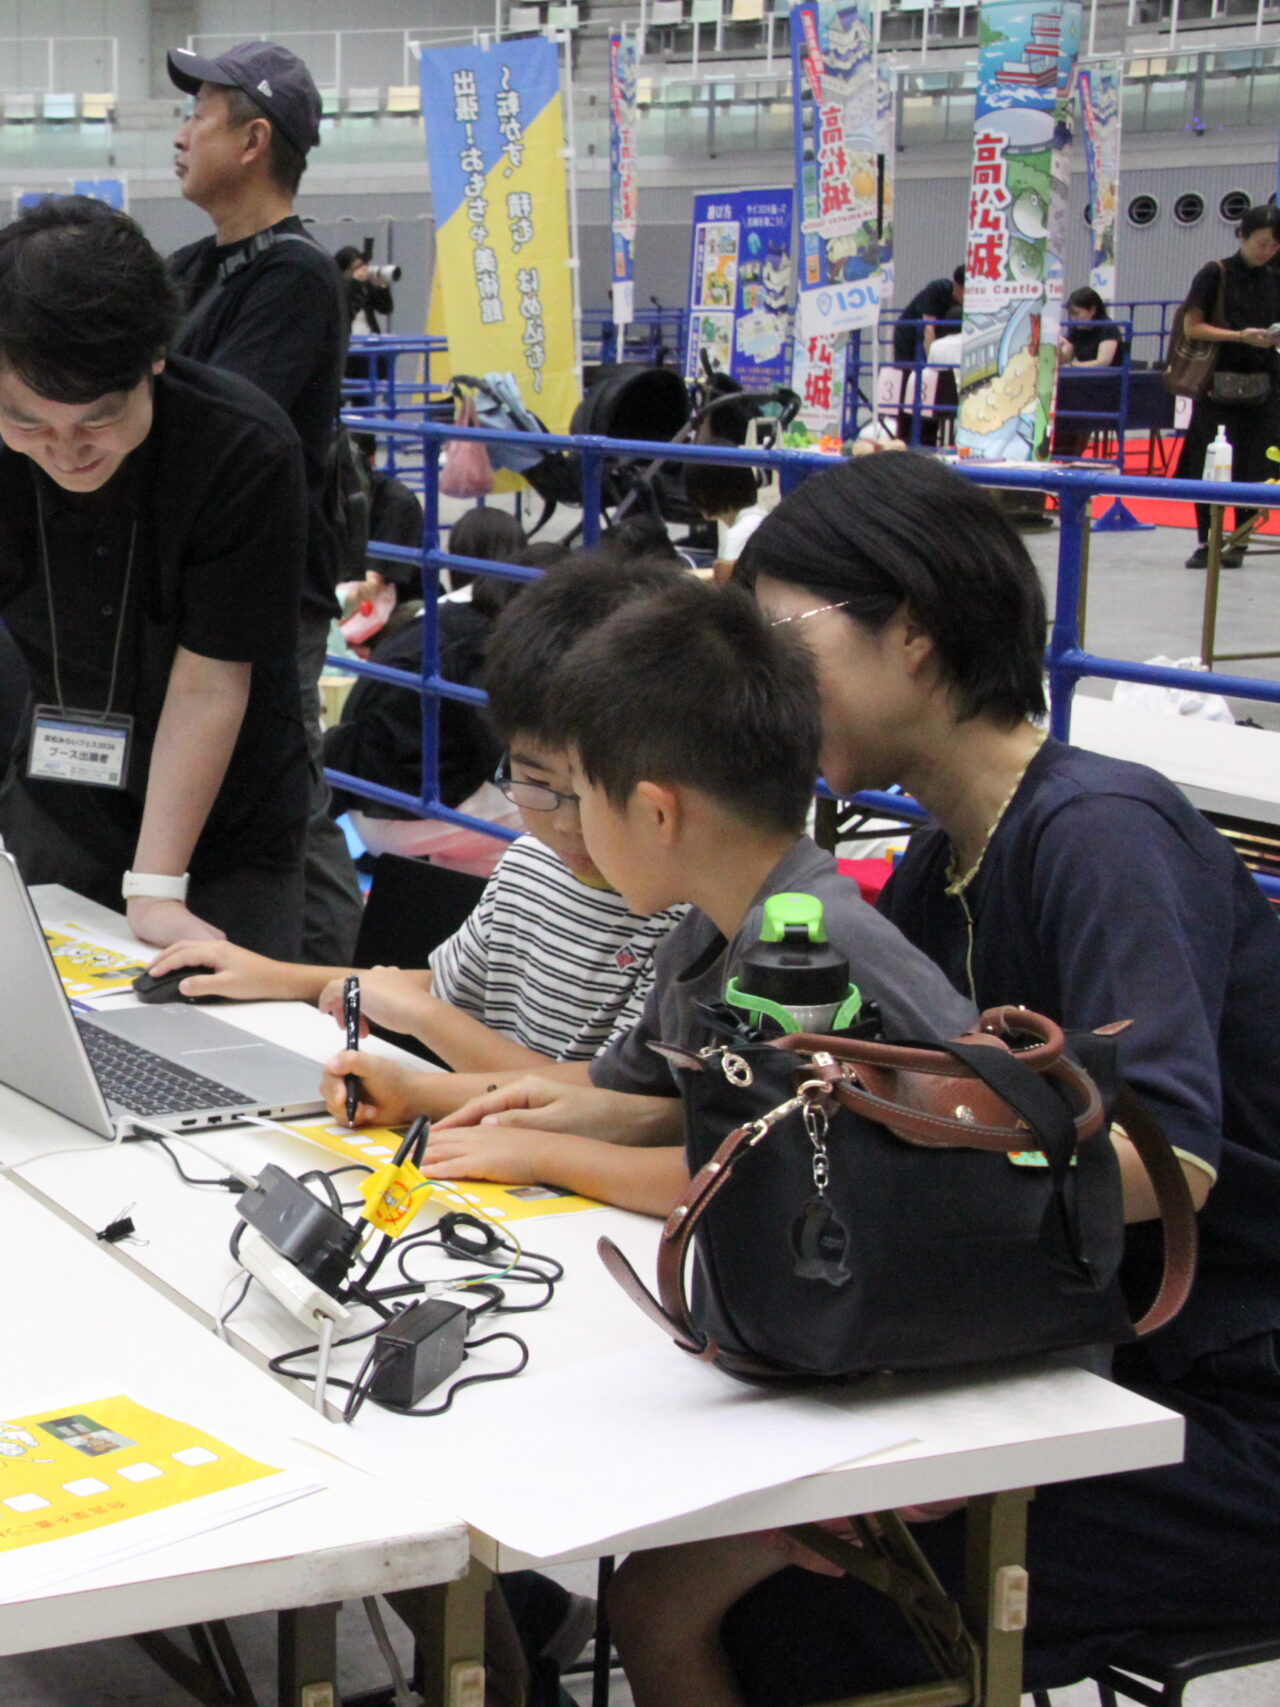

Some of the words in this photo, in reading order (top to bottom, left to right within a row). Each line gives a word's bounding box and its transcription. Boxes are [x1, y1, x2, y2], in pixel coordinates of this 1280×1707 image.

[967, 133, 1006, 281] 高松城
[993, 283, 1039, 295] Castle
[805, 335, 833, 411] 松城
[882, 380, 894, 402] 3
